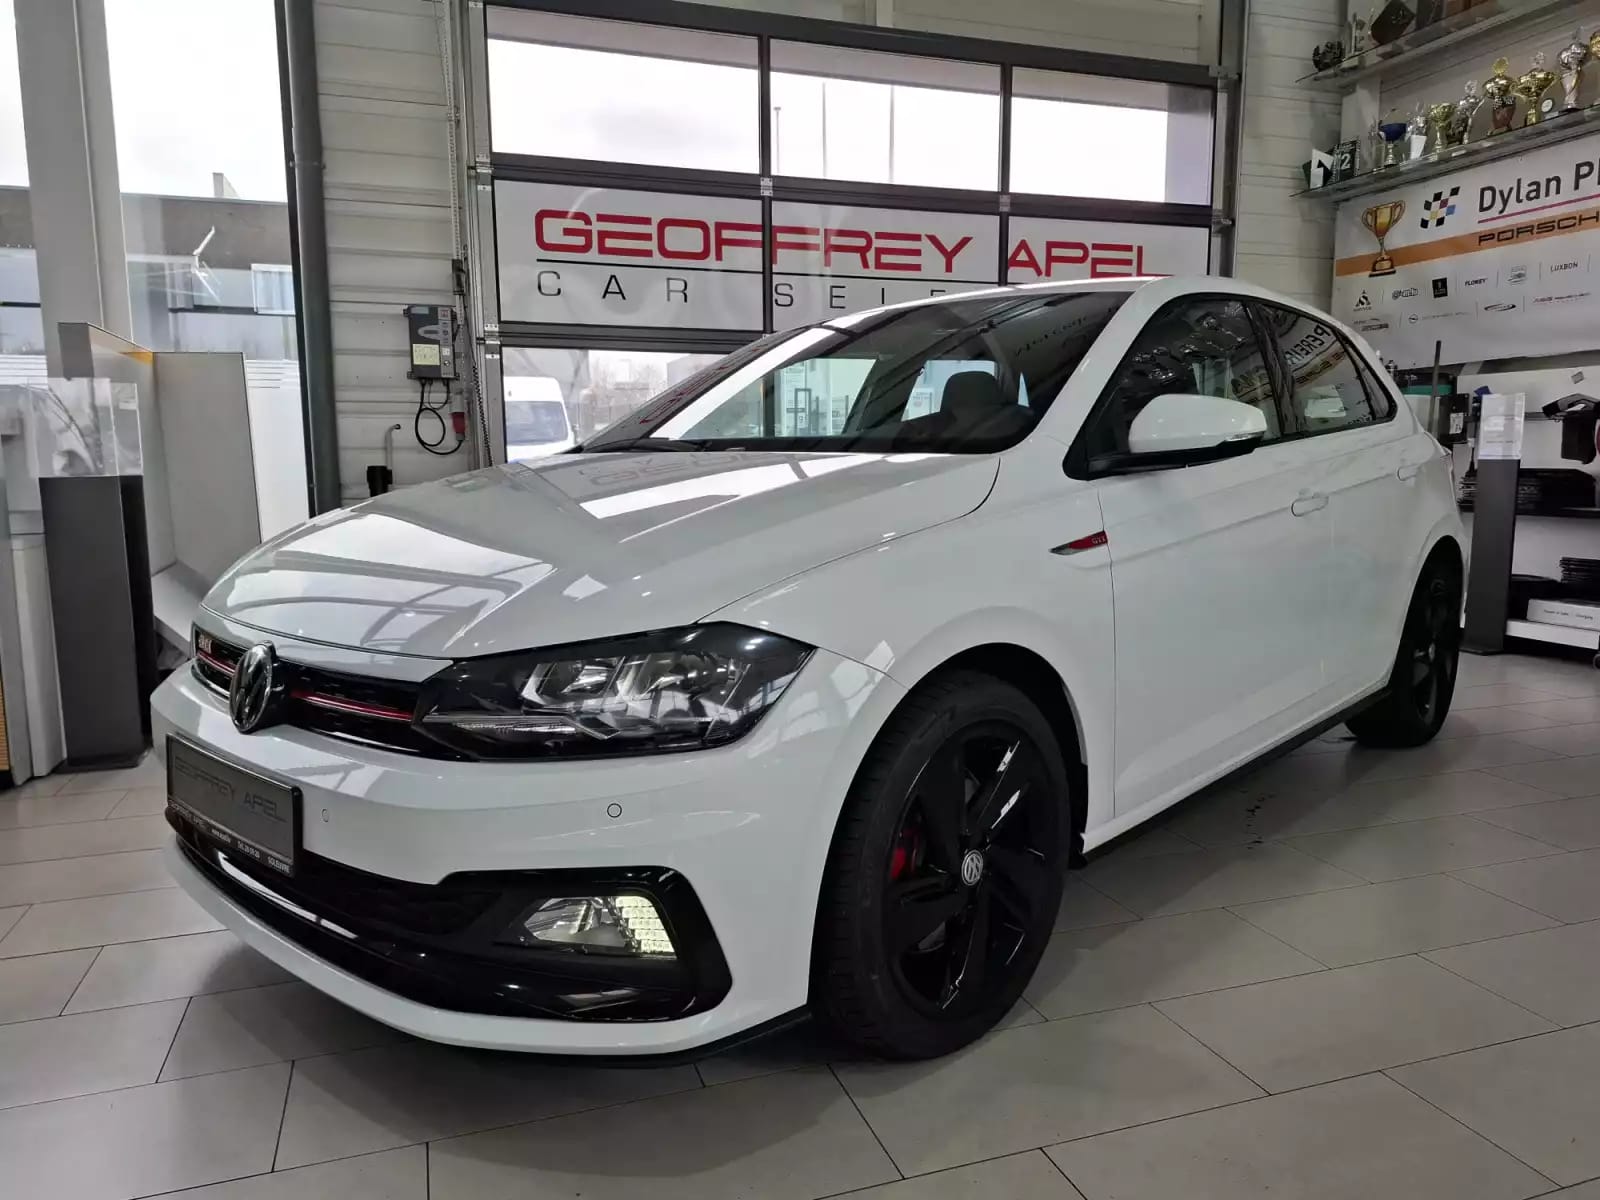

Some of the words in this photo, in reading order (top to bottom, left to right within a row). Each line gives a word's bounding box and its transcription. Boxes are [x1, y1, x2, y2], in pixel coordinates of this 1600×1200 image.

[1479, 175, 1562, 215] Dylan
[1573, 158, 1600, 191] P
[534, 208, 974, 274] GEOFFREY
[1008, 238, 1174, 279] APEL
[536, 270, 689, 303] CAR
[774, 282, 946, 309] SEL
